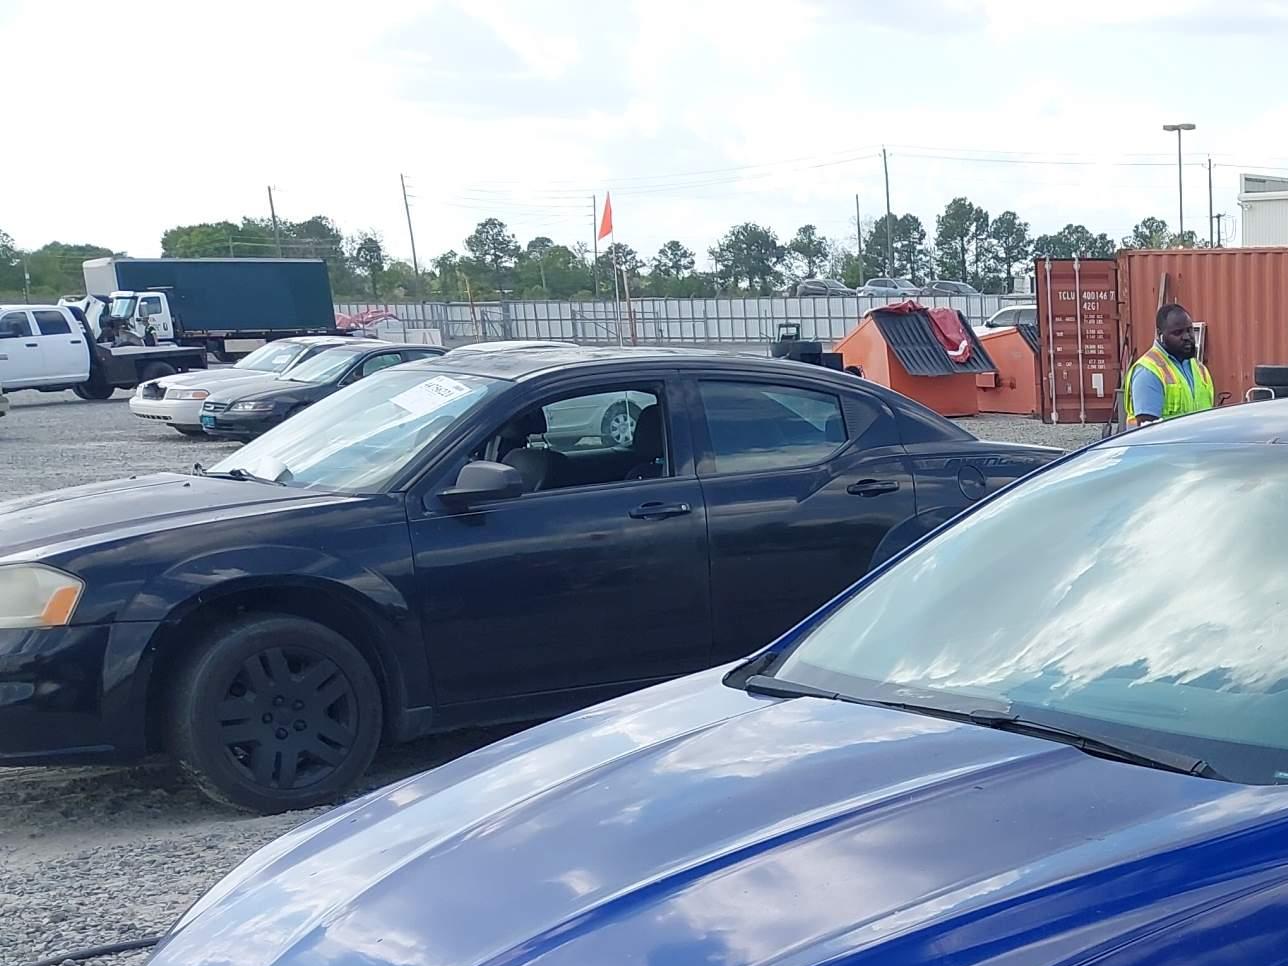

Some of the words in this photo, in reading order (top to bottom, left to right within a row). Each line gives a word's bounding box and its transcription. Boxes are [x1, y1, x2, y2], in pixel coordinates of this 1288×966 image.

[1058, 291, 1075, 300] TCLU
[1082, 291, 1107, 300] 400146
[1083, 302, 1099, 310] 42G1
